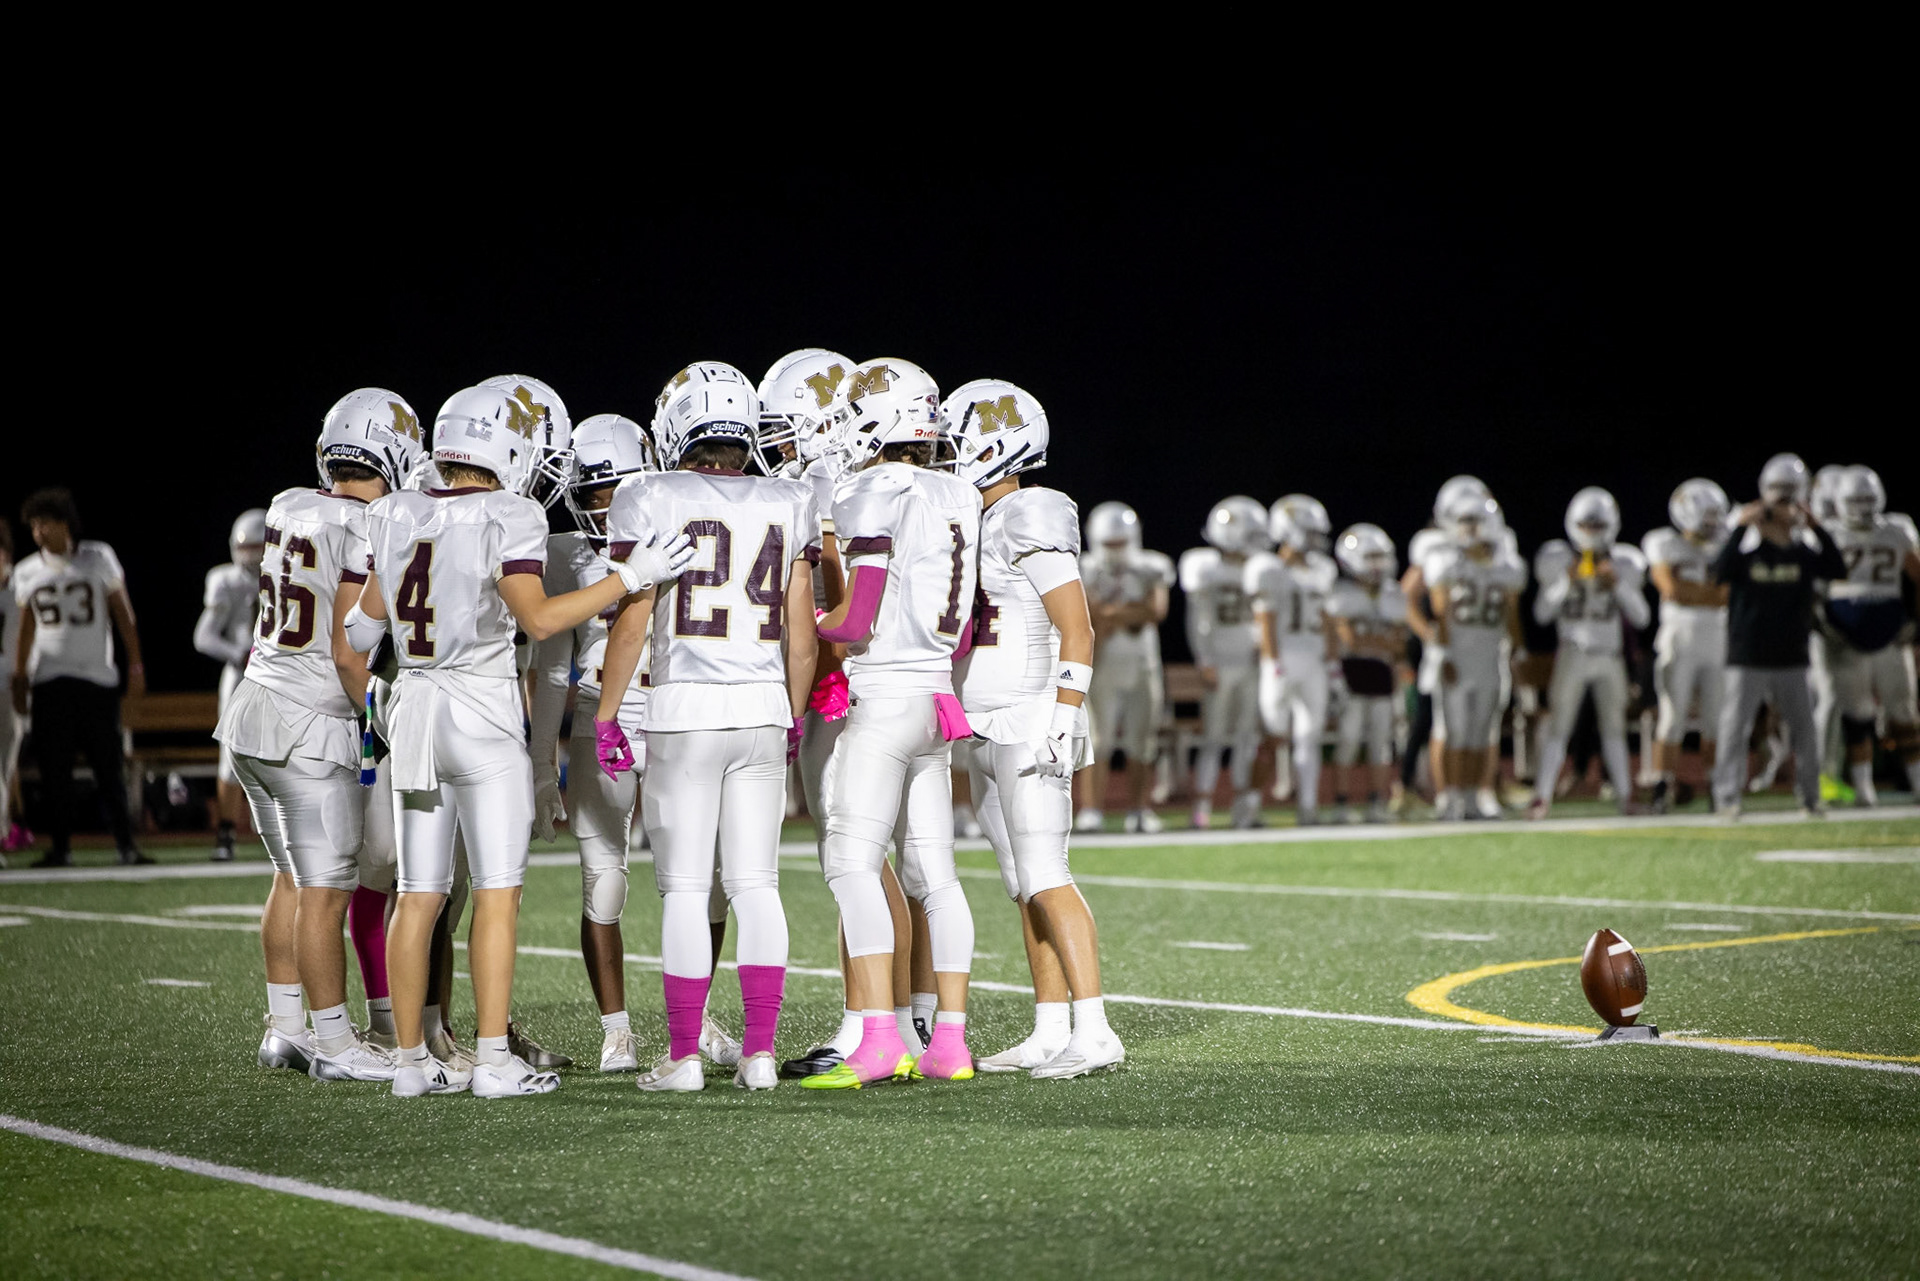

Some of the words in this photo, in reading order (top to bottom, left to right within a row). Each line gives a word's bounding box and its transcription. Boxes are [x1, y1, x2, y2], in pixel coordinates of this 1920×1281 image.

[847, 364, 890, 402] M
[387, 400, 420, 444] M
[712, 421, 746, 433] schutt
[974, 394, 1024, 435] M
[330, 445, 362, 456] schutt
[396, 539, 436, 660] 4
[675, 518, 785, 643] 24
[935, 521, 965, 637] 1
[34, 580, 95, 626] 63
